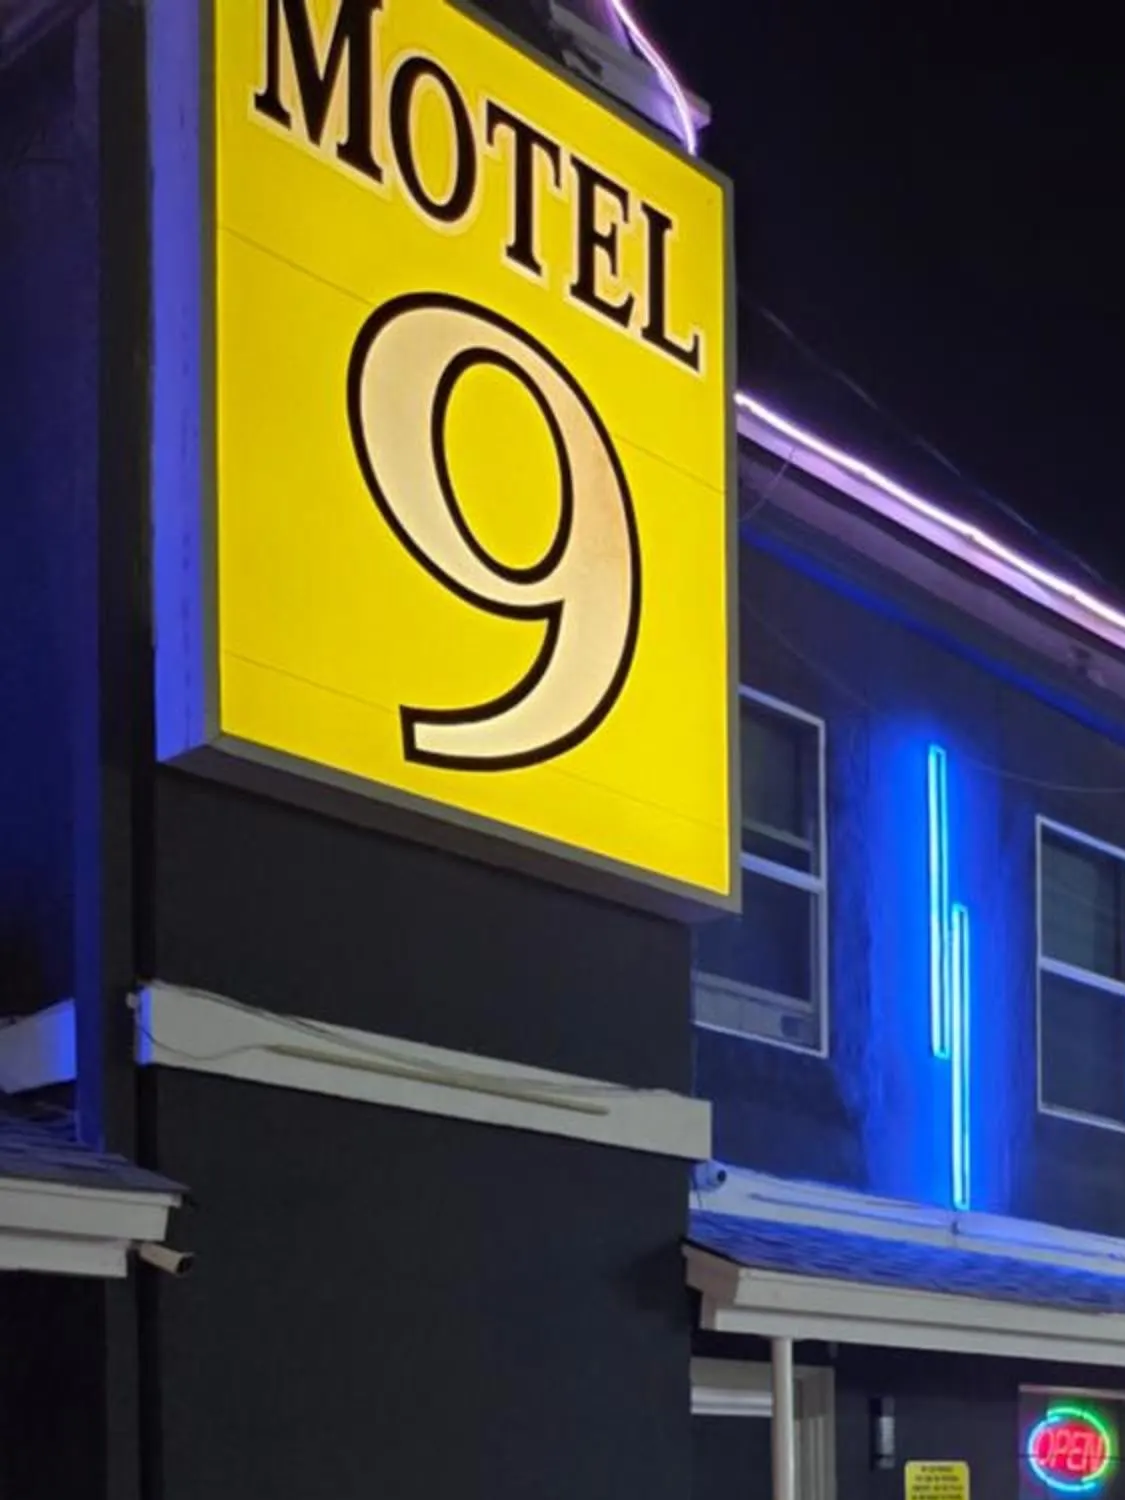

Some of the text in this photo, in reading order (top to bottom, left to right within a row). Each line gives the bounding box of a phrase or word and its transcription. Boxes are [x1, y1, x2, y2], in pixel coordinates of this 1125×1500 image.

[253, 0, 700, 372] MOTEL
[346, 292, 641, 772] 9
[1034, 1428, 1102, 1473] OPEN
